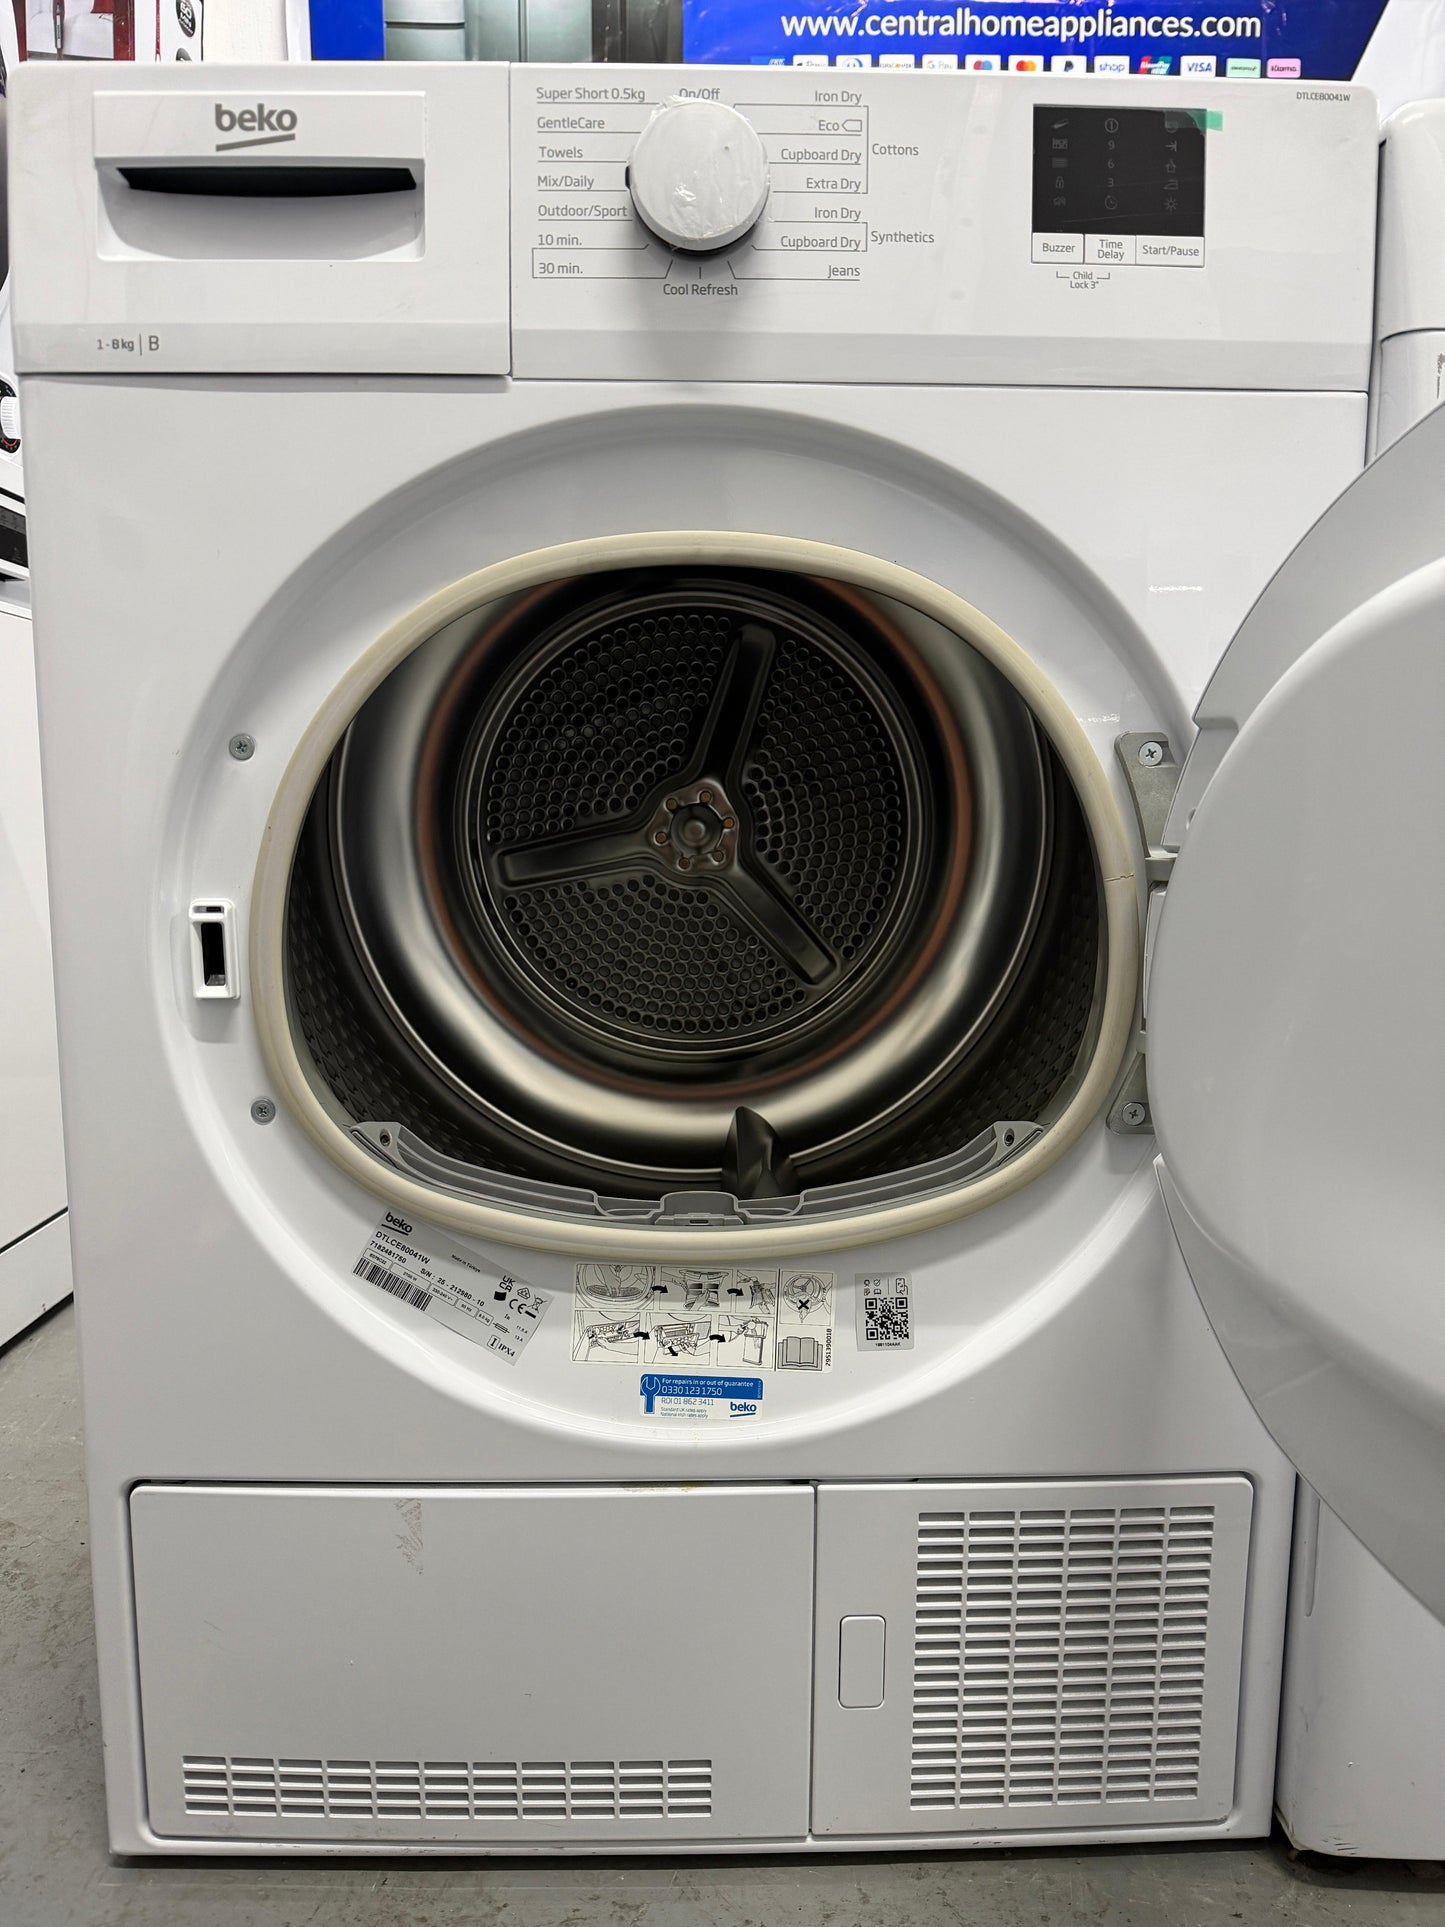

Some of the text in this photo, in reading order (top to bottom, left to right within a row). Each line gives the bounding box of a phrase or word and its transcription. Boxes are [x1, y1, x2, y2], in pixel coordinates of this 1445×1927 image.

[781, 7, 1261, 42] www.centralhomeappliances.com
[1187, 62, 1212, 73] VISA
[536, 87, 645, 103] Super Short 0.5kg
[679, 88, 720, 100] On/Off
[815, 91, 862, 105] Iron Dry
[215, 103, 297, 131] beko
[537, 117, 605, 129] GentleCare
[818, 120, 840, 131] Eco
[539, 146, 583, 158] Towels
[872, 143, 919, 156] Cottons
[781, 148, 862, 164] Cupboard Dry
[1107, 159, 1114, 168] 6
[537, 176, 594, 190] Mix/Daily
[806, 177, 861, 193] Extra Dry
[1107, 178, 1114, 187] 3
[538, 204, 627, 219] Outdoor/Sport
[814, 207, 861, 222] Iron Dry
[538, 234, 582, 246] 10 min.
[780, 235, 861, 250] Cupboard Dry
[871, 231, 935, 245] Synthetics
[1099, 239, 1123, 249] Time
[1042, 243, 1075, 253] Buzzer
[1142, 245, 1200, 256] Start/Pause
[1097, 249, 1125, 261] Delay
[538, 262, 583, 274] 30 min.
[827, 265, 860, 278] Jeans
[1072, 271, 1093, 280] Child
[663, 283, 738, 296] Cool Refresh
[1070, 280, 1089, 289] Lock
[148, 335, 160, 351] B
[385, 1212, 413, 1233] beko
[375, 1231, 430, 1264] DTLCE80041W
[672, 1379, 692, 1387] repairs
[661, 1386, 722, 1396] 0330 123 1750
[683, 1397, 696, 1405] 862
[698, 1398, 714, 1406] 3411
[730, 1401, 757, 1412] beko
